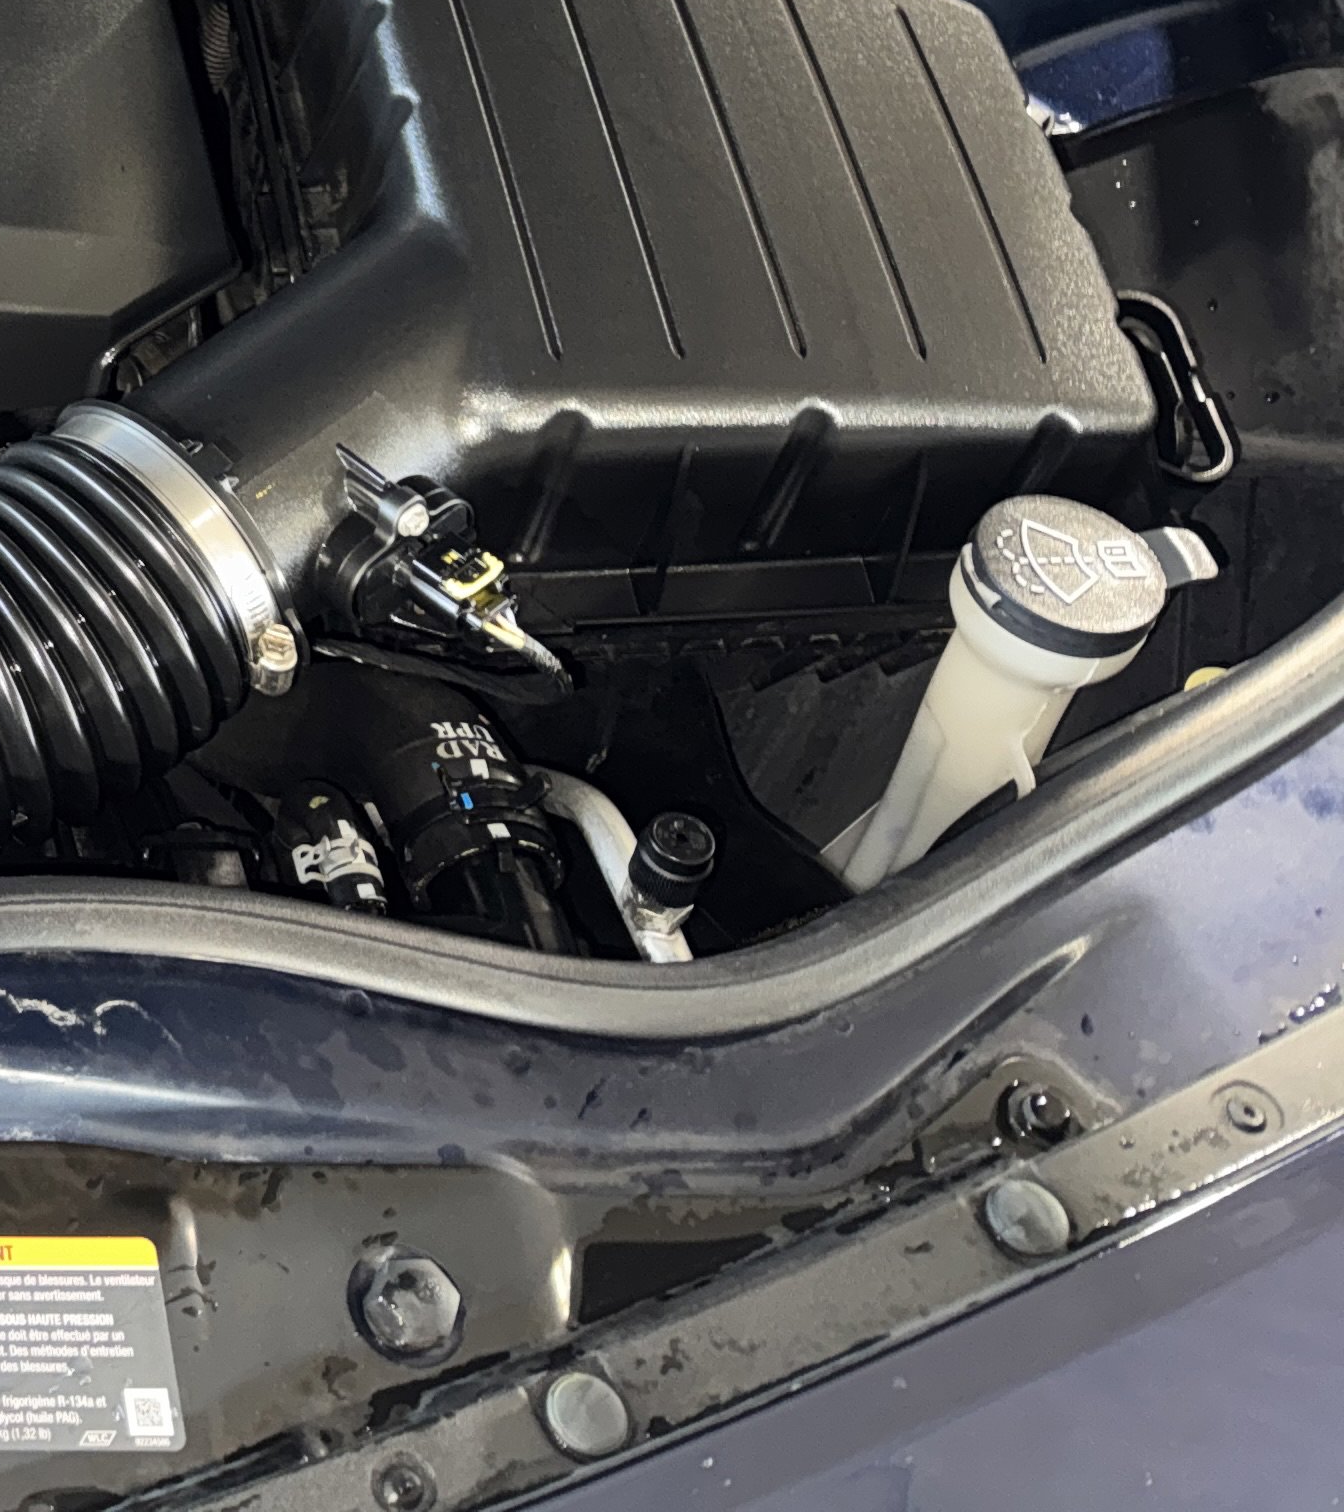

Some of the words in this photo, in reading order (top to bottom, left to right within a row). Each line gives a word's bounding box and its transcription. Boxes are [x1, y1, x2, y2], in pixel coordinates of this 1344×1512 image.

[430, 721, 495, 743] UPR
[436, 739, 507, 763] RAD
[23, 1275, 37, 1286] de
[39, 1275, 87, 1286] blessures.
[89, 1275, 101, 1286] Le
[104, 1275, 155, 1286] ventilateur
[8, 1292, 31, 1301] sans
[34, 1290, 104, 1302] avertissement.
[0, 1313, 26, 1326] SOUS
[28, 1314, 61, 1326] HAUTE
[64, 1314, 113, 1326] PRESSION
[8, 1329, 26, 1341] doit
[93, 1331, 109, 1343] par
[111, 1331, 125, 1341] un
[11, 1344, 29, 1356] Des
[0, 1361, 18, 1372] des
[58, 1395, 94, 1407] R-134a
[96, 1396, 107, 1407] et
[26, 1411, 53, 1424] (huile
[56, 1411, 82, 1425] PAG).
[39, 1427, 51, 1441] lb)
